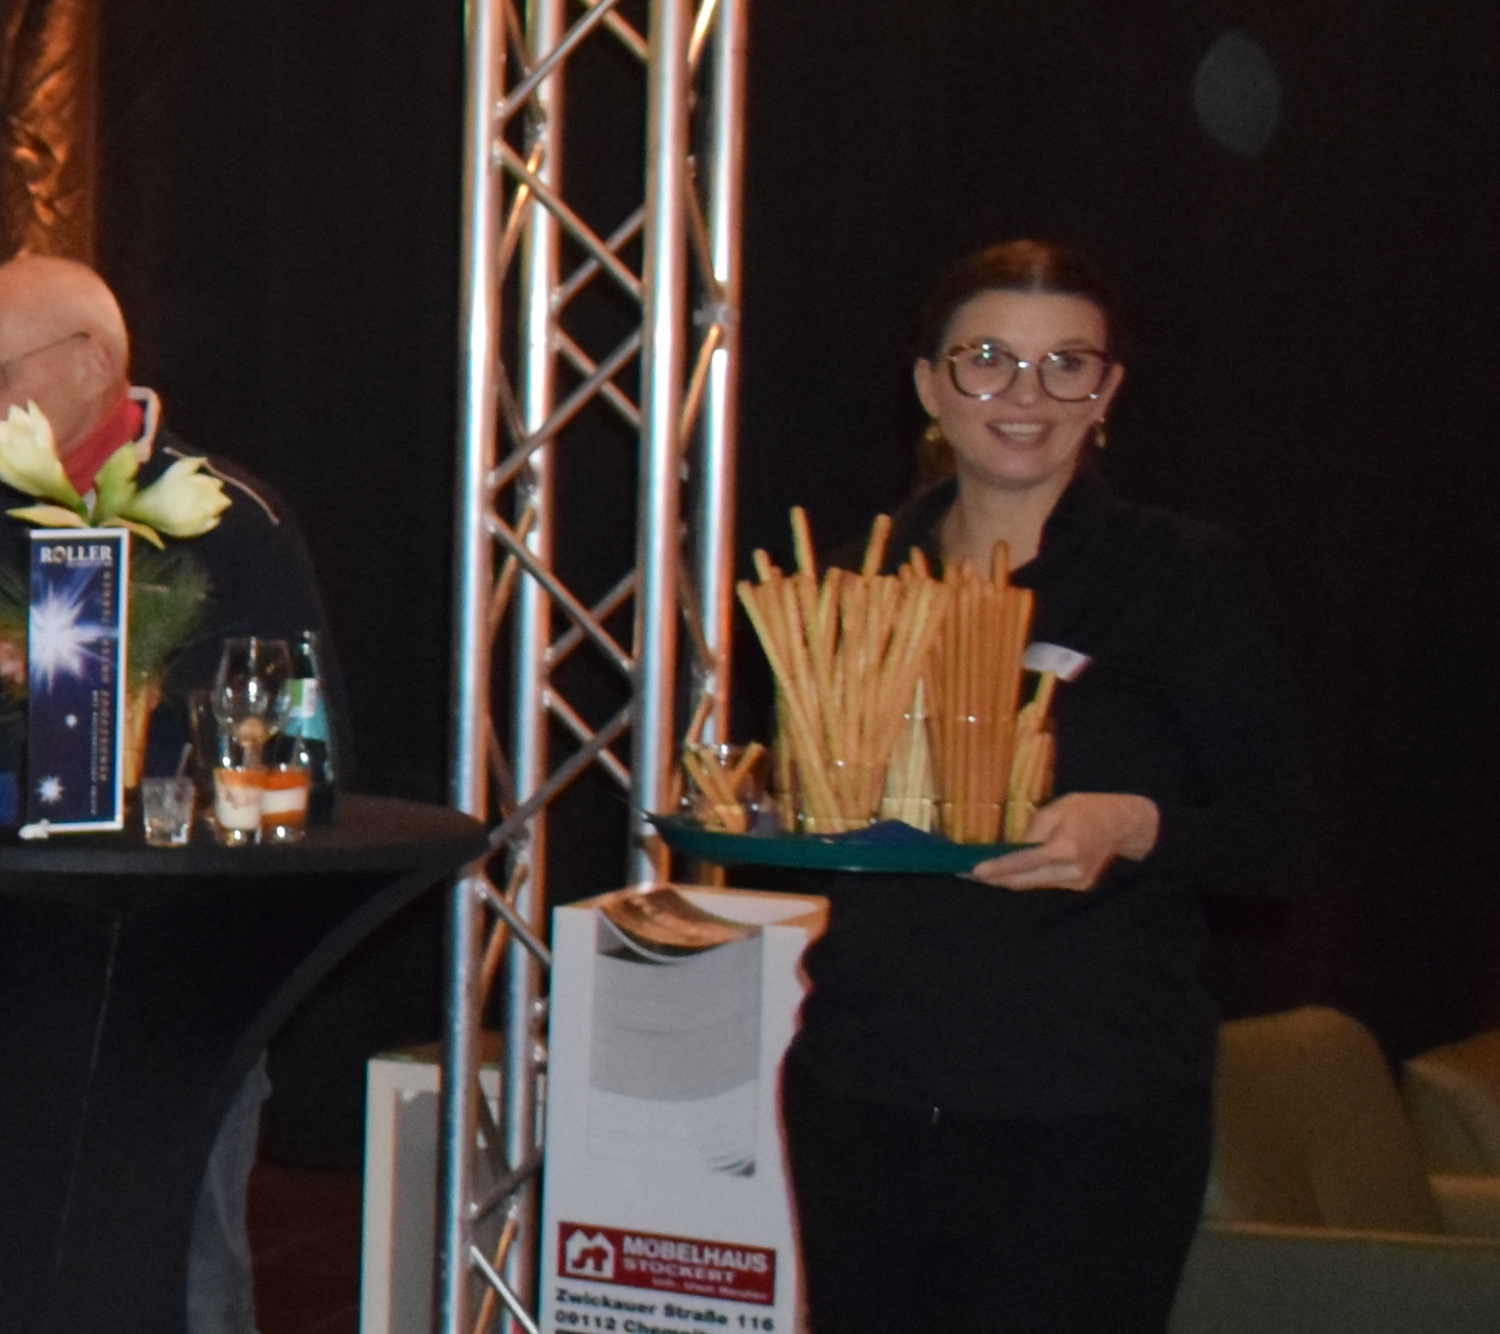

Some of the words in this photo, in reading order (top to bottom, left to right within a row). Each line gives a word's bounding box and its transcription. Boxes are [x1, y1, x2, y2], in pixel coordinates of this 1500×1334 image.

[623, 1258, 736, 1283] STOCKERT
[556, 1288, 657, 1314] Zwickauer
[663, 1304, 728, 1325] Straße
[555, 1310, 616, 1330] 09112
